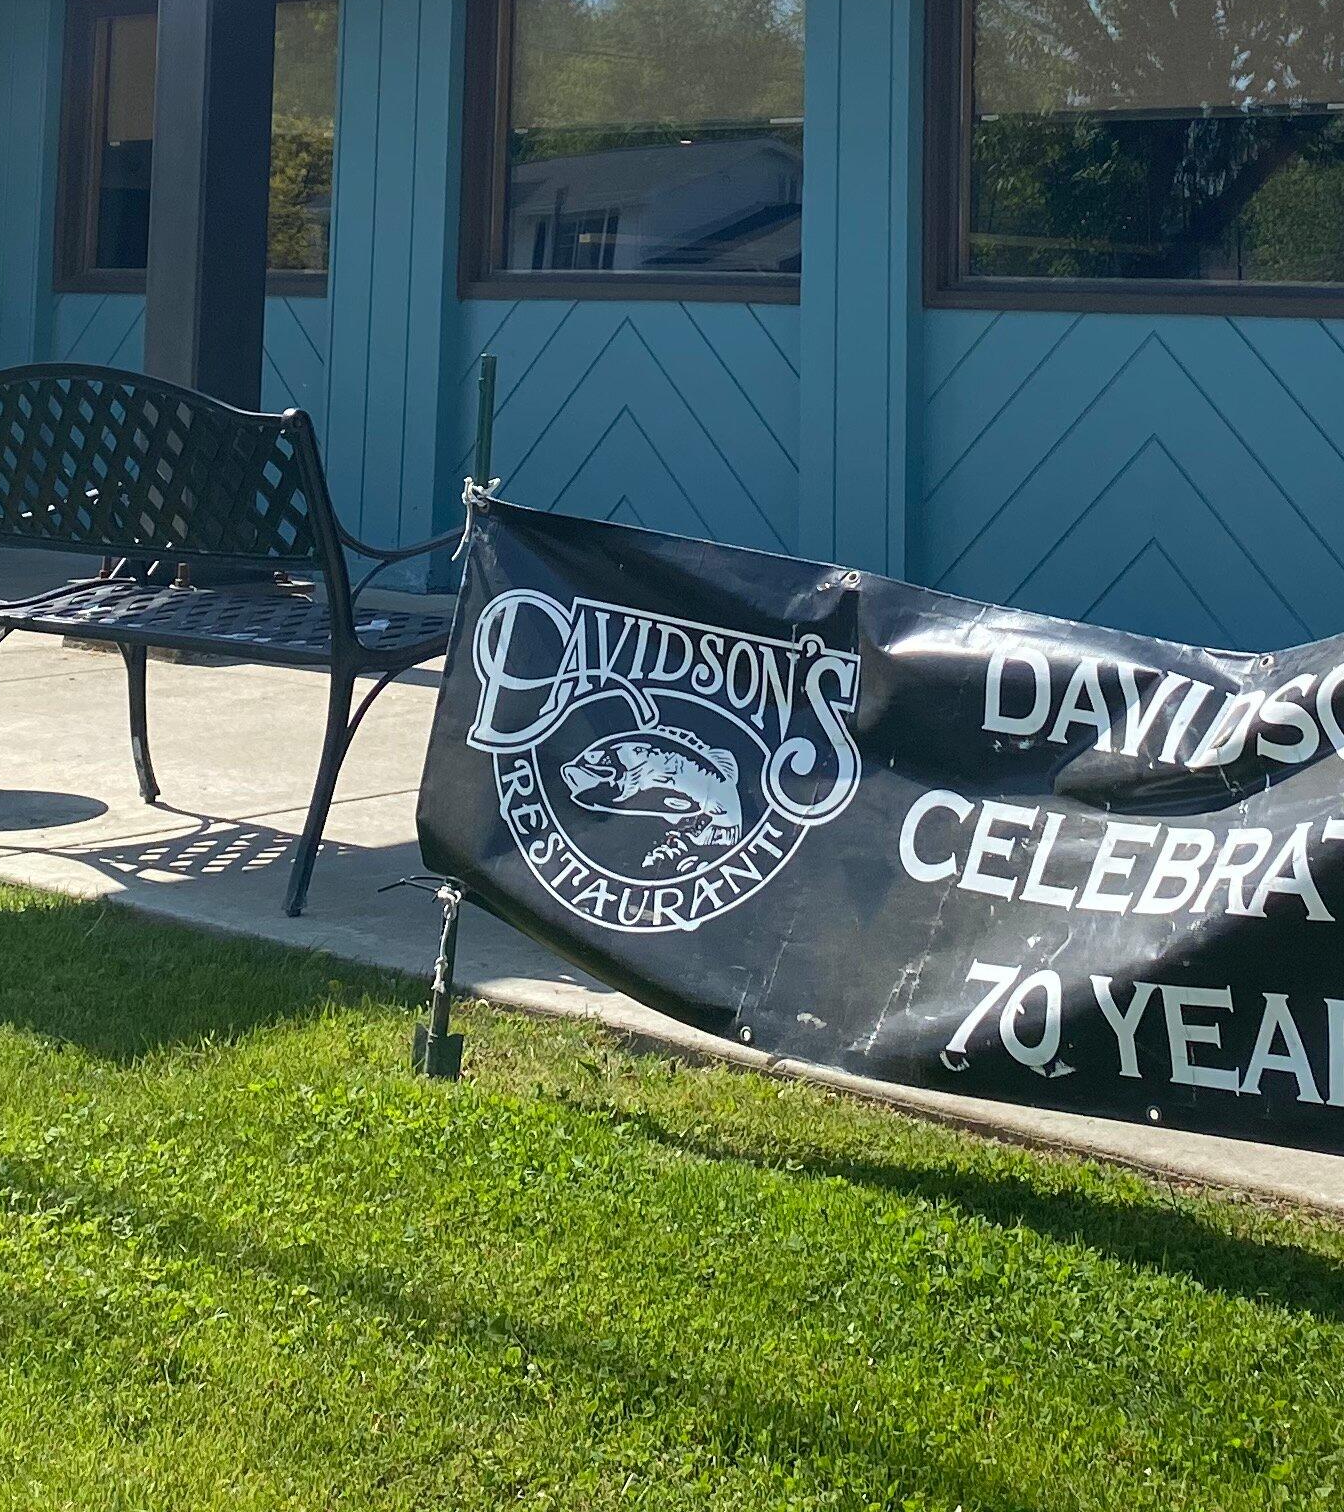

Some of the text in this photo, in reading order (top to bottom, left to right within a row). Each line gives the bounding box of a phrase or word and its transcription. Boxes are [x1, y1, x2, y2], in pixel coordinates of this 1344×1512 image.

[467, 589, 860, 824] DAVIDSON'S
[500, 758, 784, 929] RESTAURANT
[941, 958, 1076, 1078] 70
